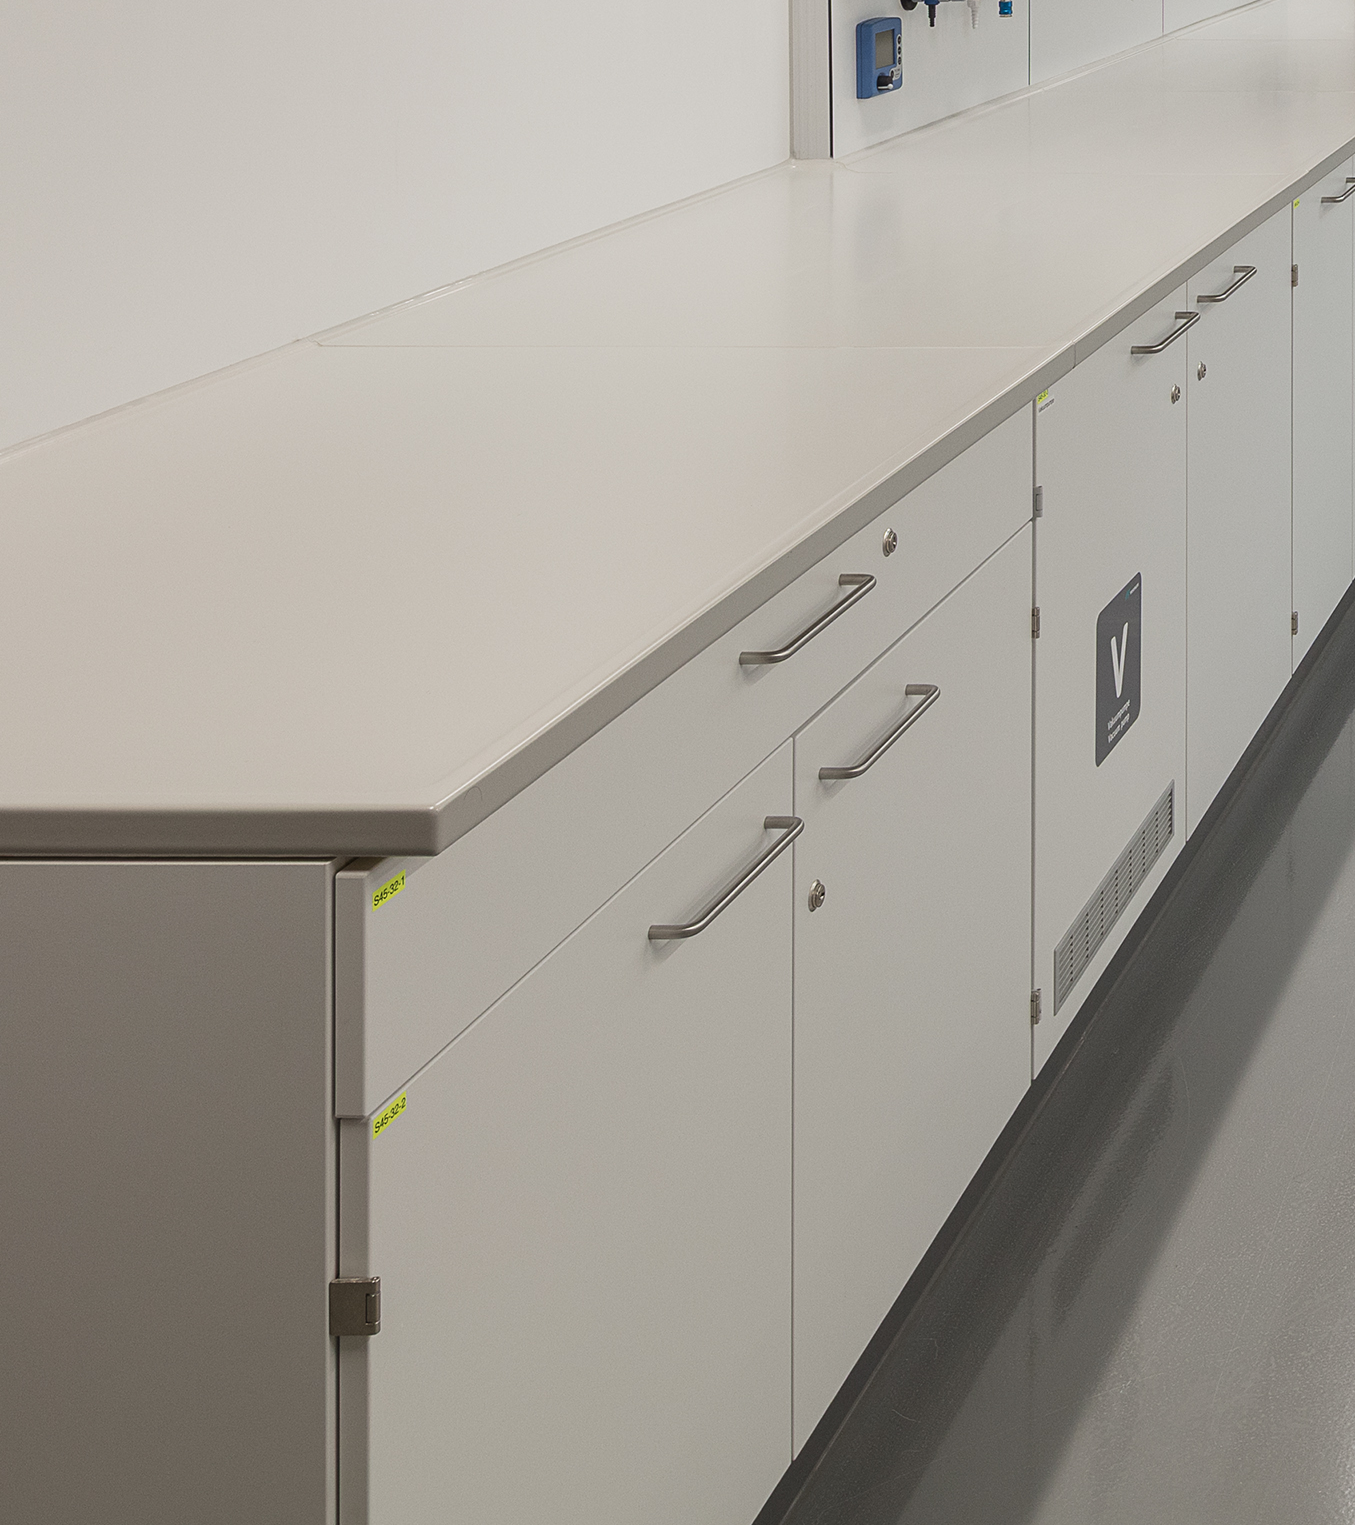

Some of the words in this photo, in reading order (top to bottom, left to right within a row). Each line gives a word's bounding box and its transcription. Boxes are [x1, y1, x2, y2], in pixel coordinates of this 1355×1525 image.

[1110, 621, 1129, 699] V
[1108, 724, 1121, 744] Vacuum
[1120, 713, 1130, 731] pump
[373, 875, 406, 907] S45-32-1
[374, 1097, 407, 1134] S45-32-2
